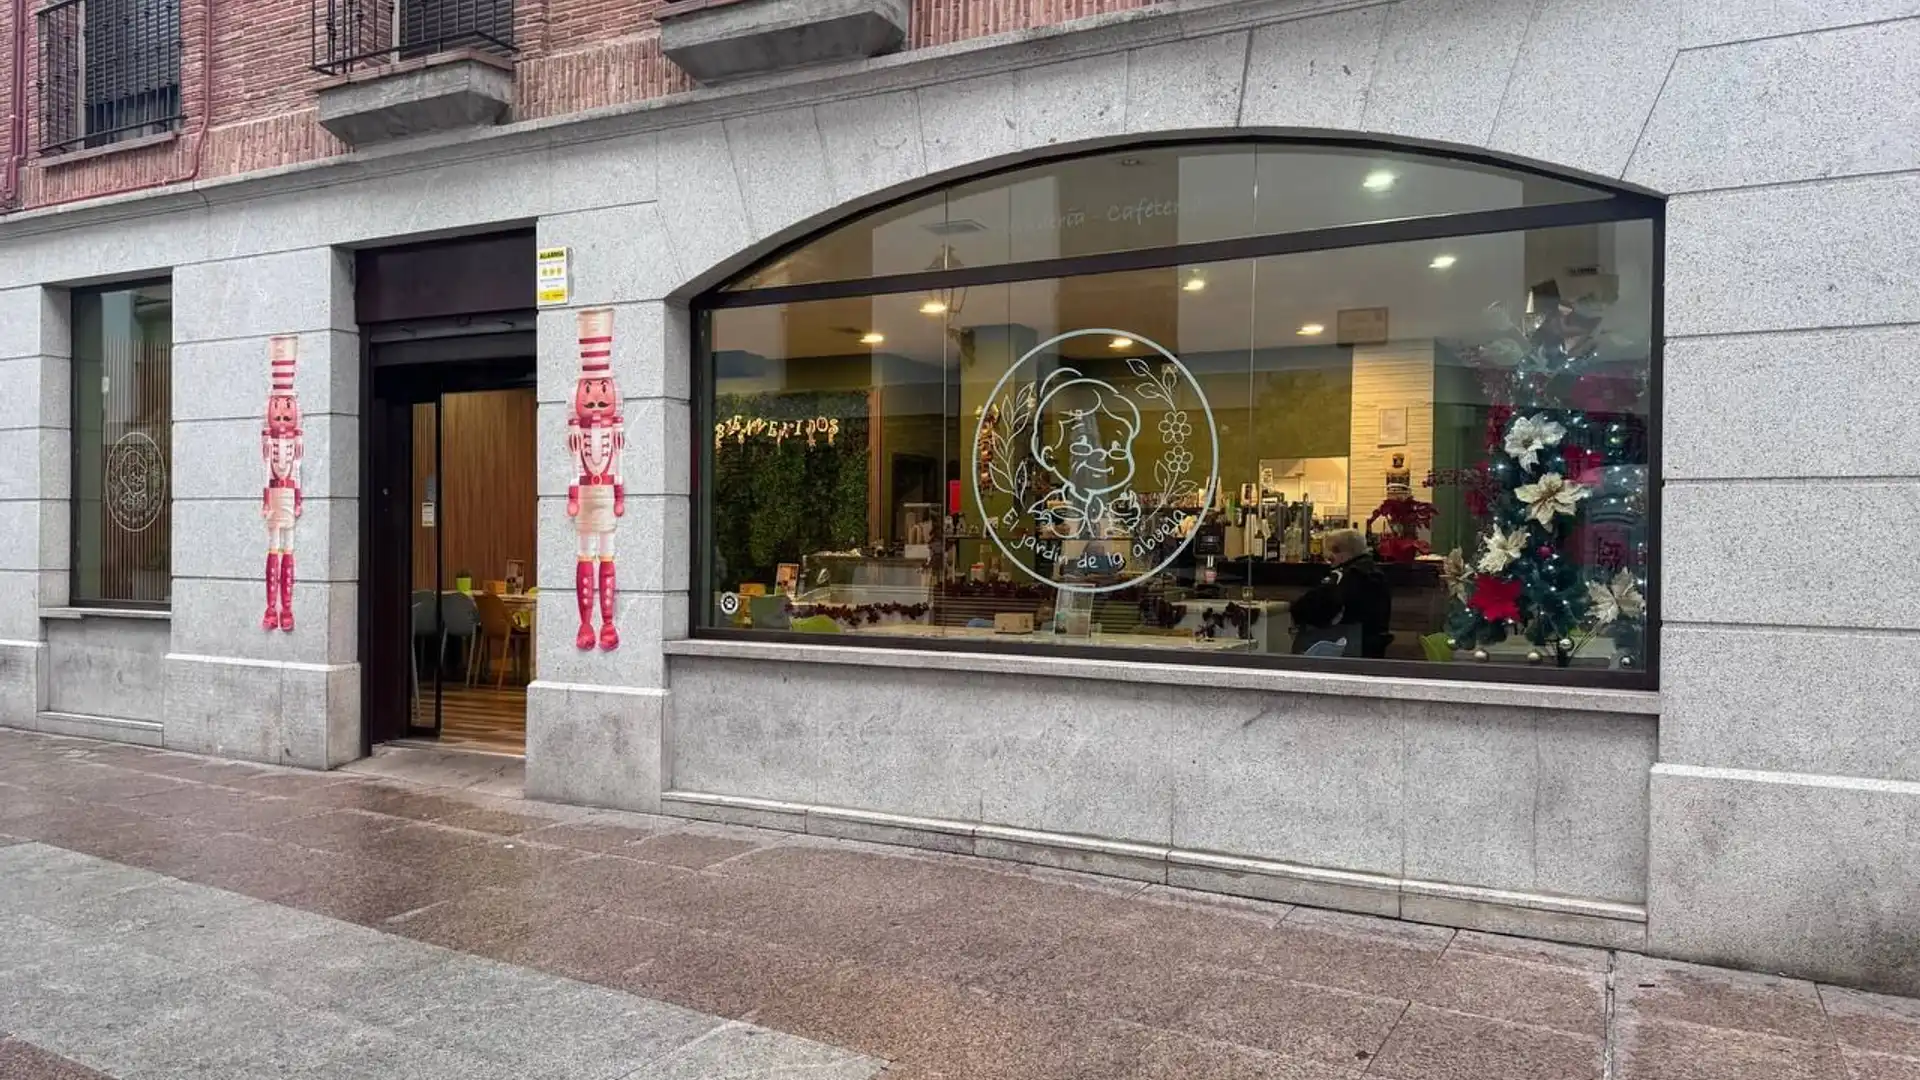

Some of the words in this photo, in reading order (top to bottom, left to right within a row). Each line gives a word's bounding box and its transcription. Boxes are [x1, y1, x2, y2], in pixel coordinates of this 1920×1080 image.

[1002, 507, 1020, 532] El
[1076, 552, 1099, 569] de
[1106, 551, 1126, 568] la
[1132, 509, 1187, 557] abuela
